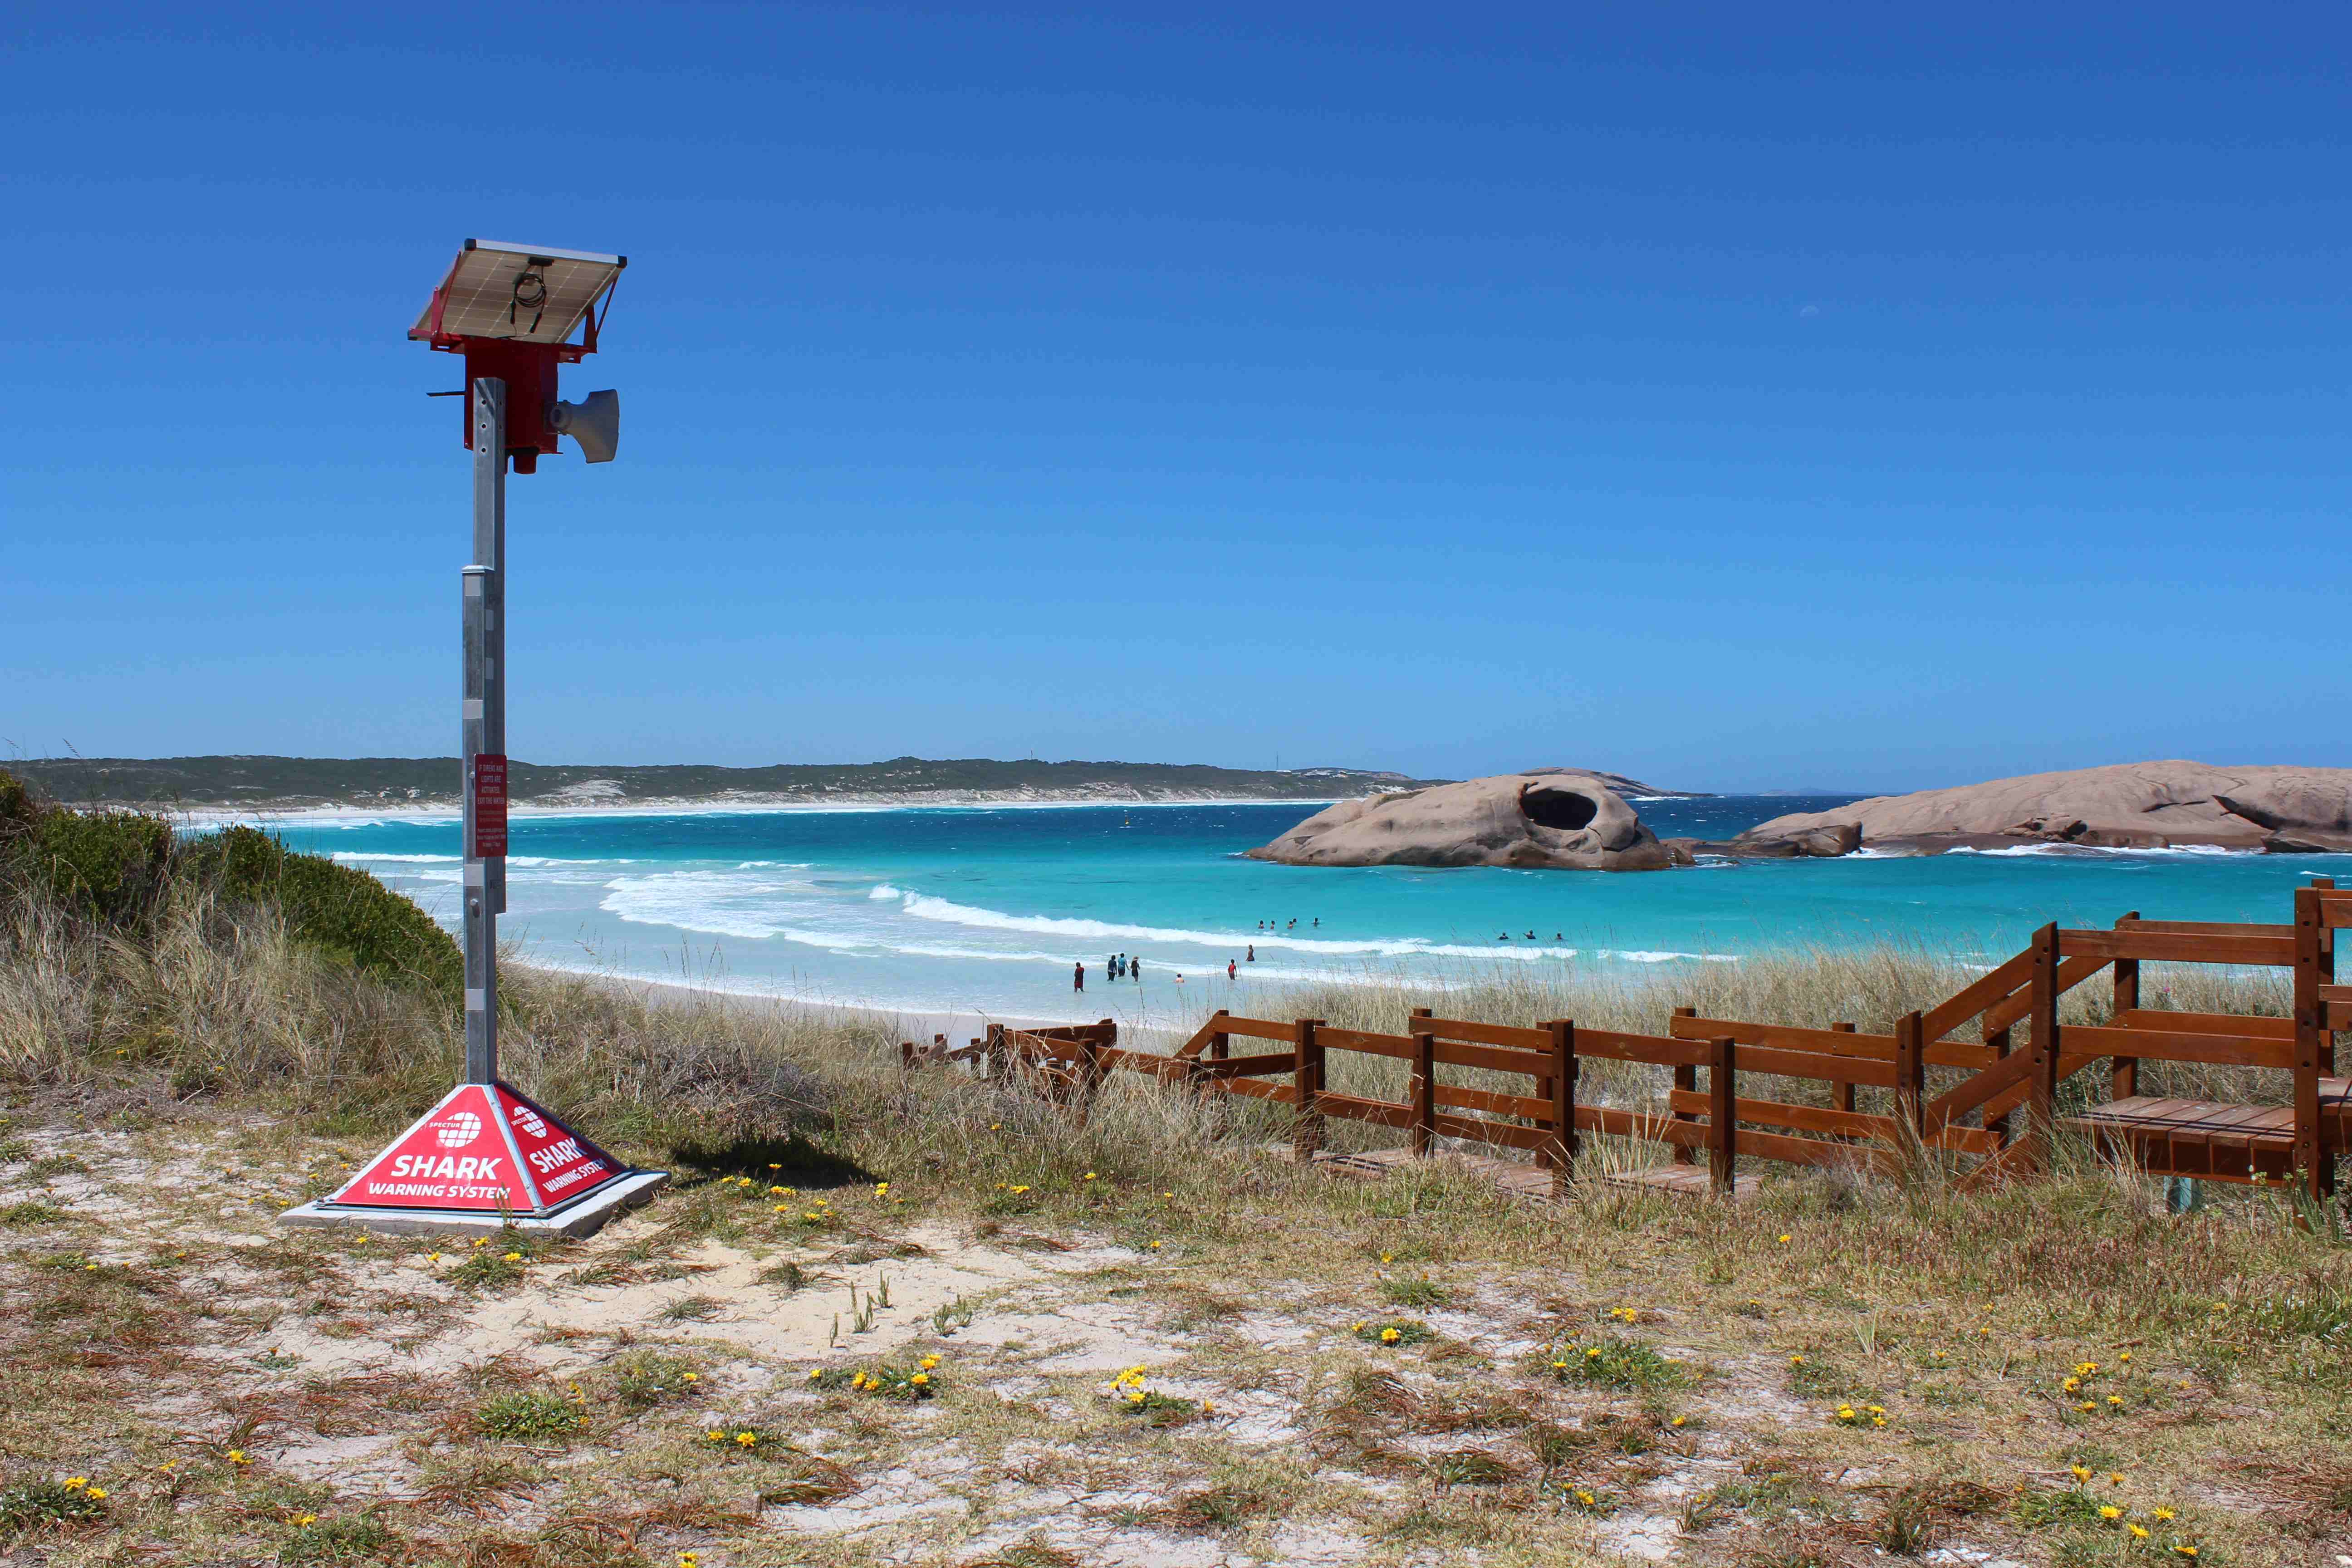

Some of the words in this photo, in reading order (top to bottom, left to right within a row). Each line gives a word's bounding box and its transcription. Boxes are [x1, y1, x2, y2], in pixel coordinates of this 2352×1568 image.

[391, 1155, 502, 1180] SHARK
[529, 1137, 588, 1174] SHARK
[542, 1169, 583, 1193] WARNING
[578, 1157, 608, 1177] SYSTEM
[369, 1182, 446, 1197] WARNING
[447, 1185, 511, 1199] SYSTEM
